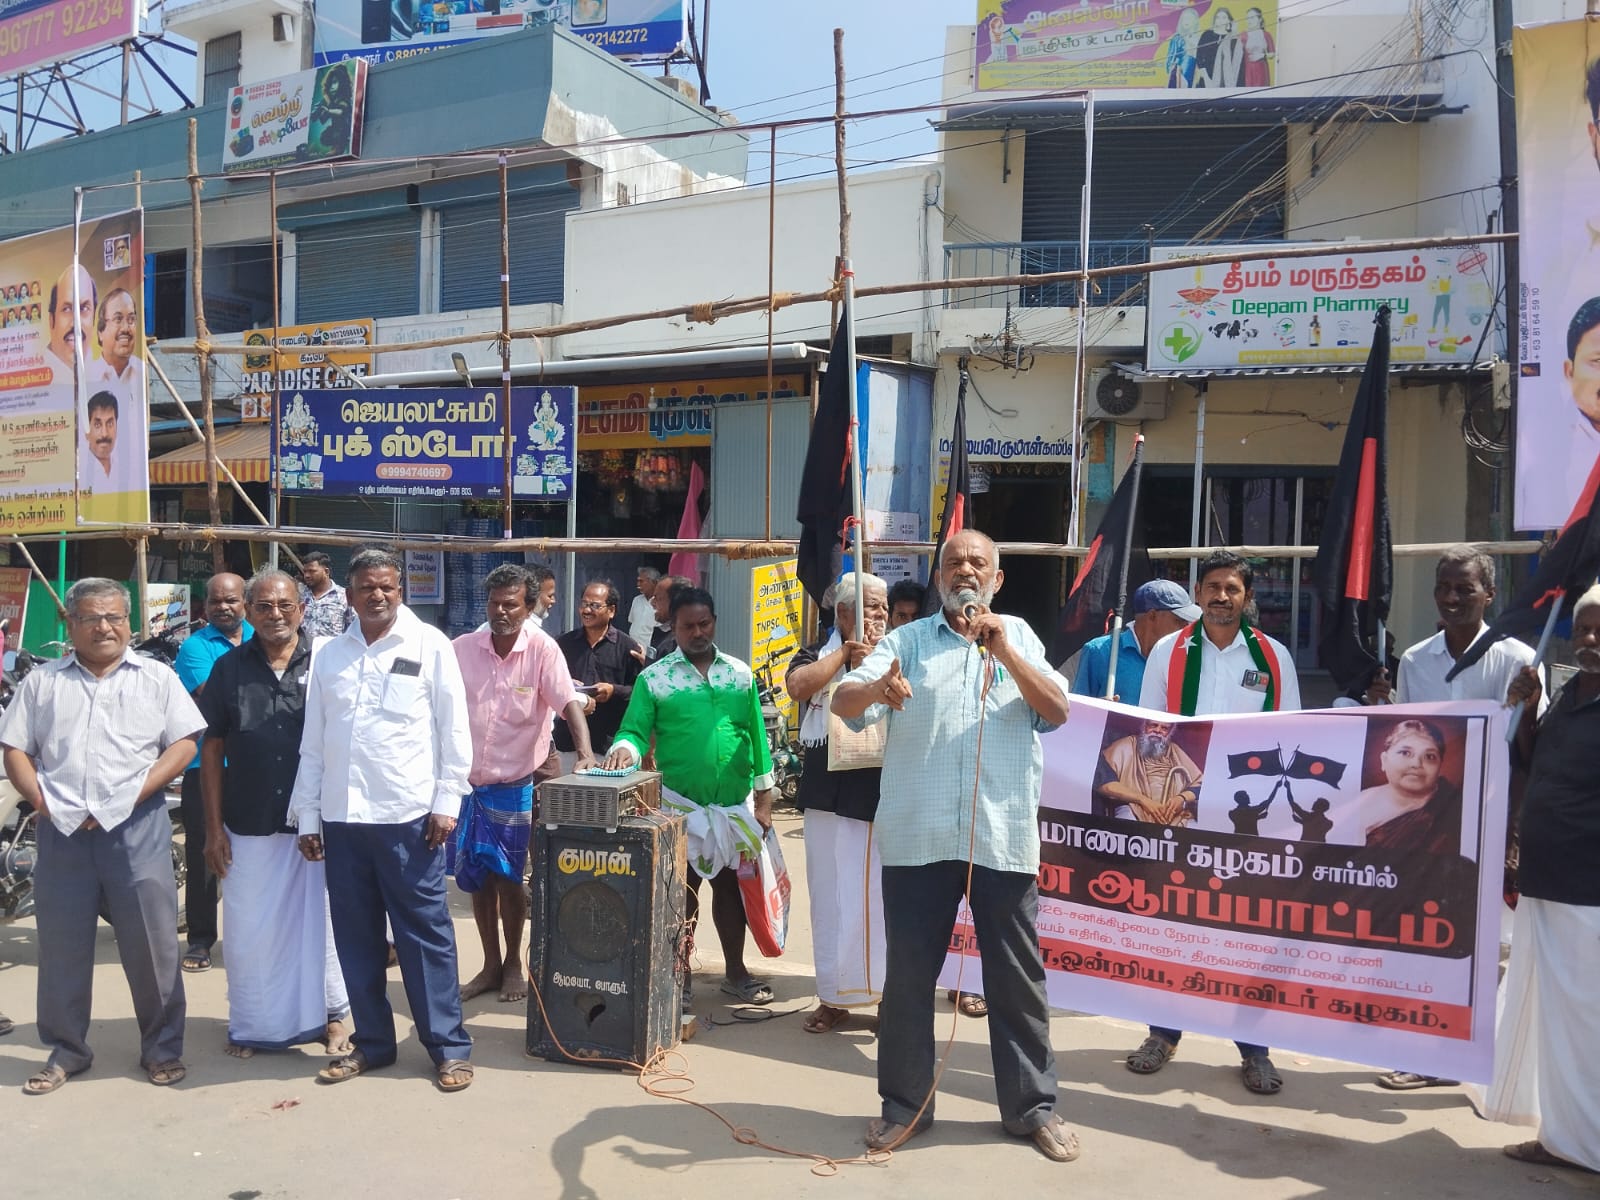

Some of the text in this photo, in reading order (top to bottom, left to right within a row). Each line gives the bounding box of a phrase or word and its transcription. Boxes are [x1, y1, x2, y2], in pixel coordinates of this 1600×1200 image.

[0, 0, 124, 57] 96777 92234
[1222, 260, 1282, 294] தீபம்
[1290, 254, 1427, 293] மருந்தகம்
[1232, 298, 1308, 318] Deepam
[241, 366, 321, 394] PARADISE
[341, 392, 496, 425] ஜெயலட்சுமி
[323, 425, 517, 462] புக் ஸ்டோர்
[387, 466, 447, 478] 9994740697
[16, 503, 66, 529] ஒன்றியம்
[756, 617, 780, 633] TNPSC
[557, 845, 637, 877] குமரன்.
[1040, 820, 1398, 889] மாணவர் கழகம் சார்பில்
[1087, 869, 1455, 948] ஆர்ப்பாட்டம்
[1164, 926, 1211, 945] நேரம்
[1223, 939, 1278, 954] காலை
[1283, 946, 1332, 962] 10.00
[1338, 954, 1383, 969] மணி
[1190, 950, 1346, 983] திருவண்ணாமலை
[1352, 975, 1433, 995] மாவட்டம்
[1180, 972, 1319, 1010] திராவிடர்
[1328, 1004, 1449, 1030] கழகம்.
